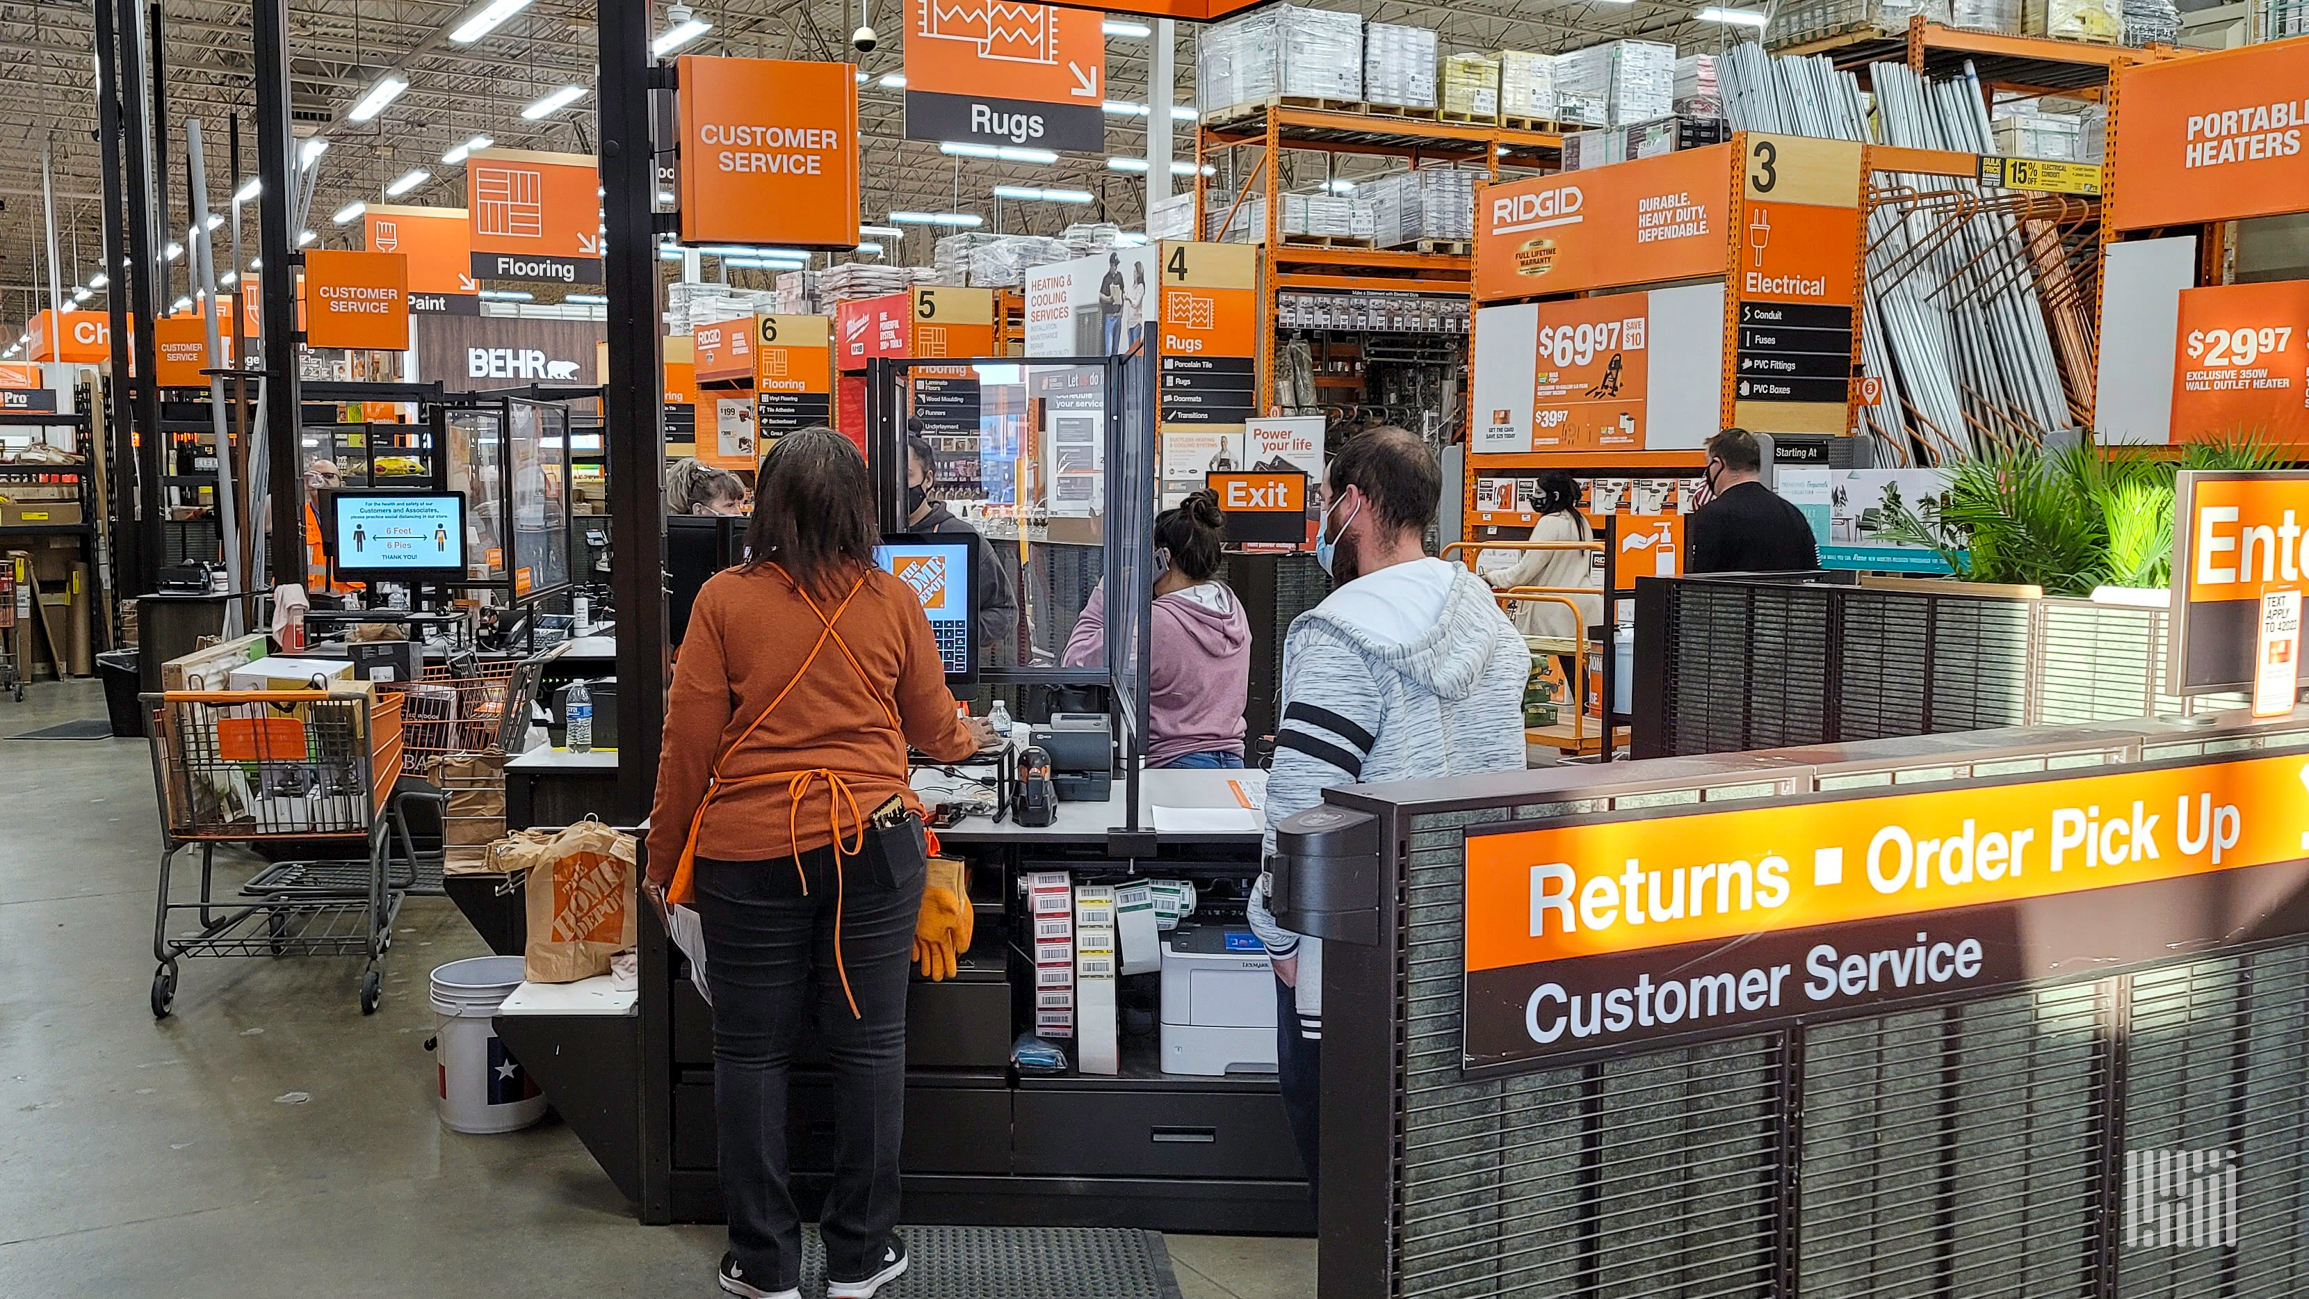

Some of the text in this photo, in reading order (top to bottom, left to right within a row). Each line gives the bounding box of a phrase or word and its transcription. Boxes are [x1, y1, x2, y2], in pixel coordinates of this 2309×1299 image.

[970, 103, 1045, 143] Rugs
[700, 124, 838, 150] CUSTOMER
[2186, 129, 2301, 169] HEATERS
[719, 151, 822, 175] SERVICE
[1751, 140, 1776, 193] 3
[1984, 157, 2001, 166] BULK
[2042, 164, 2067, 172] ELECTRICAL
[1493, 186, 1583, 225] RIDGID
[1639, 192, 1690, 213] DURABLE.
[1638, 205, 1707, 228] HEAVY DUTY.
[1638, 221, 1709, 244] DEPENDABLE.
[1515, 248, 1556, 260] FULL LIFETIME
[1520, 256, 1552, 267] WARRANTY
[497, 257, 576, 282] Flooring
[1167, 246, 1188, 281] 4
[1031, 274, 1072, 292] HEATING &
[1745, 271, 1826, 296] Electrical
[319, 286, 398, 301] CUSTOMER
[1031, 291, 1067, 307] COOLING
[329, 300, 389, 314] SERVICE
[408, 295, 446, 311] Paint
[918, 289, 936, 319] 5
[1030, 306, 1069, 323] SERVICES
[1754, 310, 1782, 320] Conduit
[761, 317, 778, 342] 6
[846, 313, 870, 337] Milwaukee
[1625, 321, 1642, 331] SAVE
[74, 322, 110, 345] Ch
[697, 328, 721, 345] RIDGID
[1625, 332, 1642, 346] $10
[1754, 335, 1776, 345] Fuses
[161, 343, 203, 352] CUSTOMER
[890, 338, 903, 349] TOOLS
[1166, 334, 1203, 353] Rugs
[166, 353, 199, 362] SERVICE
[468, 347, 547, 380] BEHR
[918, 365, 967, 377] Flooring
[1753, 360, 1796, 371] PVC Fittings
[1067, 372, 1099, 387] Let do
[1175, 378, 1191, 386] Rugs
[2186, 368, 2268, 381] EXCLUSIVE 350W
[762, 378, 805, 391] Flooring
[1753, 384, 1791, 394] PVC Boxes
[1867, 385, 1873, 393] 2
[2185, 378, 2290, 391] WALL OUTLET HEATER
[4, 391, 28, 404] Pro
[780, 395, 798, 403] Flooring
[1055, 400, 1104, 409] your service
[720, 407, 736, 416] $199
[1253, 428, 1293, 440] Power
[1262, 438, 1313, 454] your life
[1776, 447, 1817, 459] Starting At
[1227, 480, 1288, 507] Exit
[2266, 596, 2286, 608] TEXT
[2265, 608, 2290, 620] APPLY
[2265, 622, 2275, 633] TO
[1528, 791, 2243, 938] Returns Order Pick Up
[562, 861, 588, 896] THE
[574, 889, 623, 940] DEPOT
[1525, 931, 1984, 1044] Customer Service
